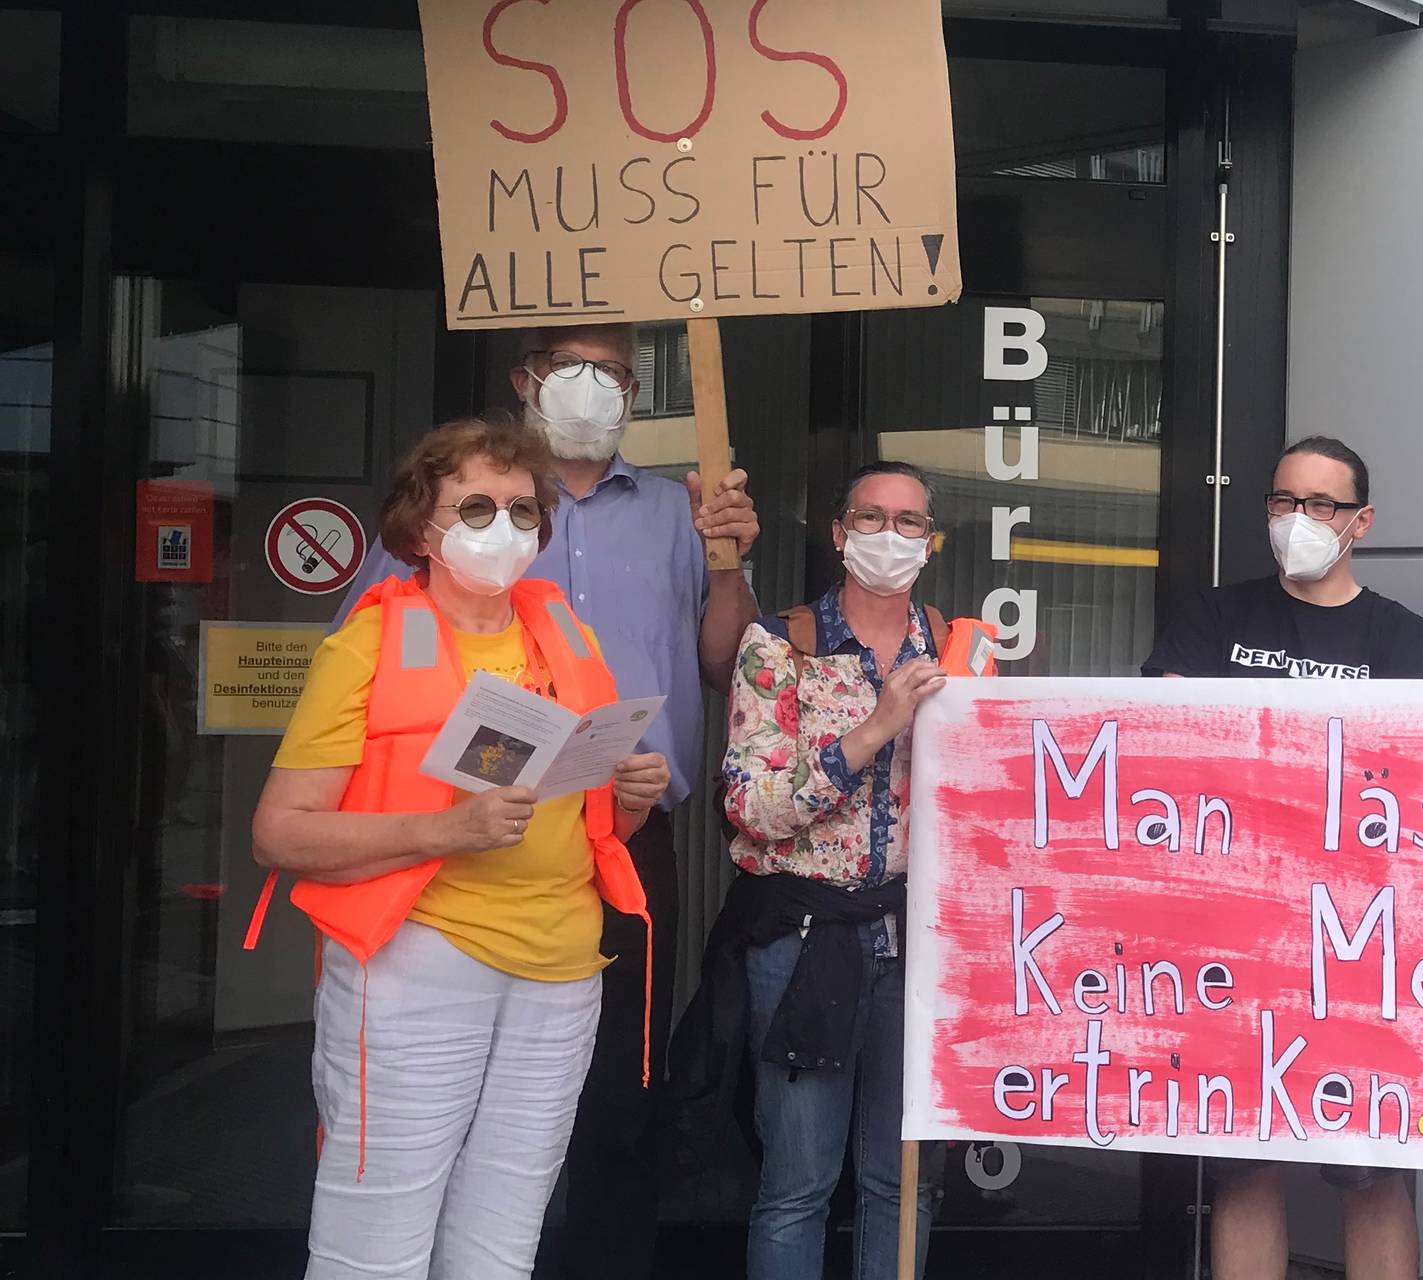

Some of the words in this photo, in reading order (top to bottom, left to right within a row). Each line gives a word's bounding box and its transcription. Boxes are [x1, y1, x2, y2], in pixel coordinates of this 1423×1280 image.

[483, 0, 847, 143] SOS
[489, 158, 699, 232] MUSS
[752, 150, 891, 227] FÜR
[458, 247, 608, 313] ALLE
[659, 233, 944, 302] GELTEN!
[256, 641, 282, 652] Bitte
[286, 641, 308, 652] den
[257, 670, 280, 680] und
[283, 670, 305, 680] den
[1032, 719, 1233, 855] Man
